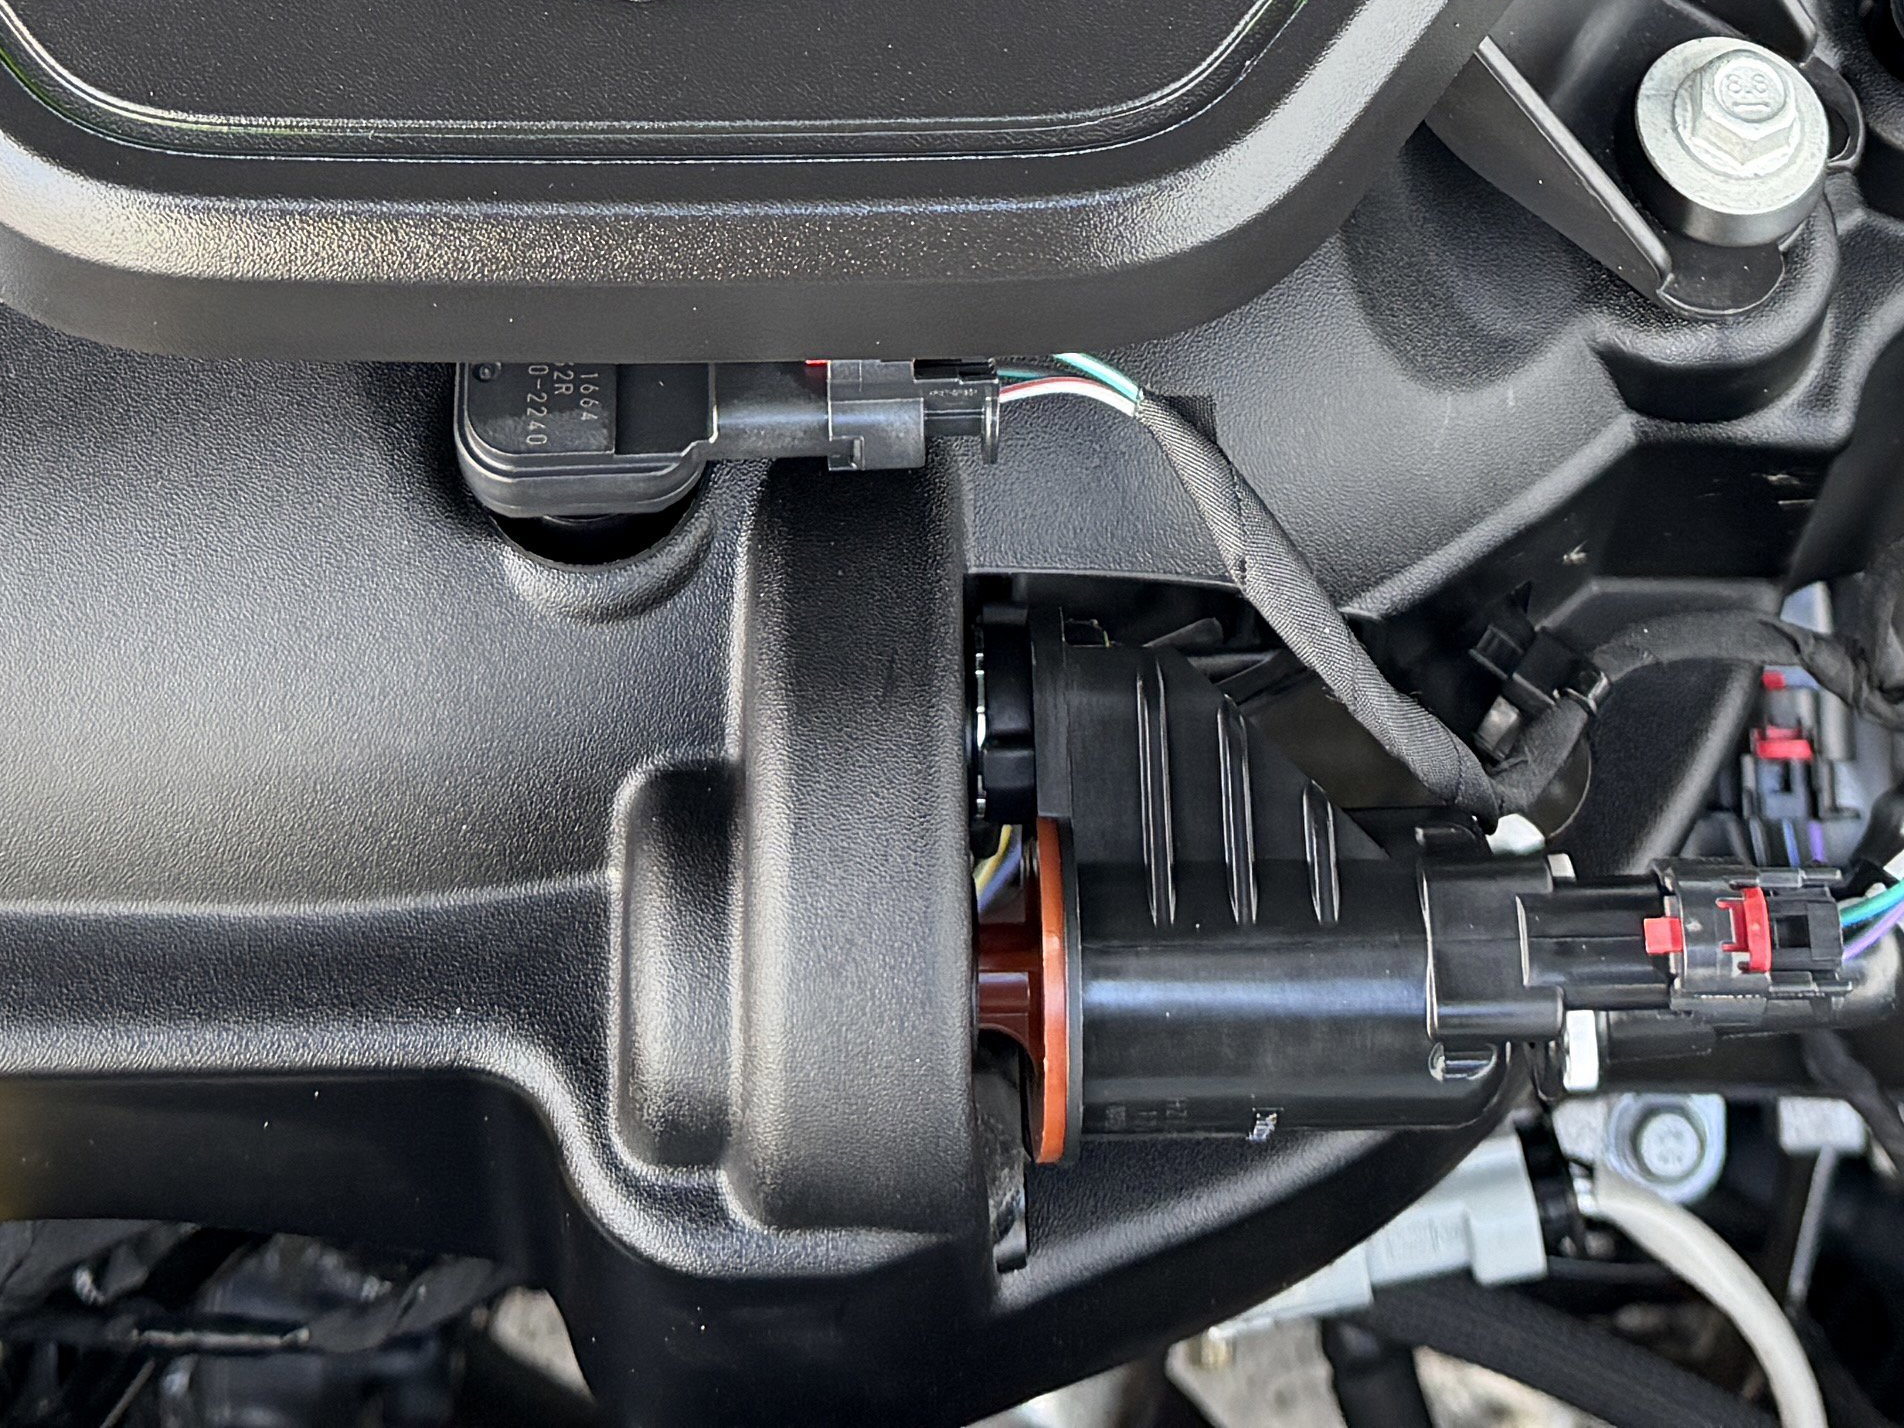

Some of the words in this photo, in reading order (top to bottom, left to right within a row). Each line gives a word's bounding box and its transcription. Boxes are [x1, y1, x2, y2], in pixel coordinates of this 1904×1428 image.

[553, 363, 575, 395] 2R
[579, 372, 599, 421] 1664
[526, 364, 550, 445] 0-2240
